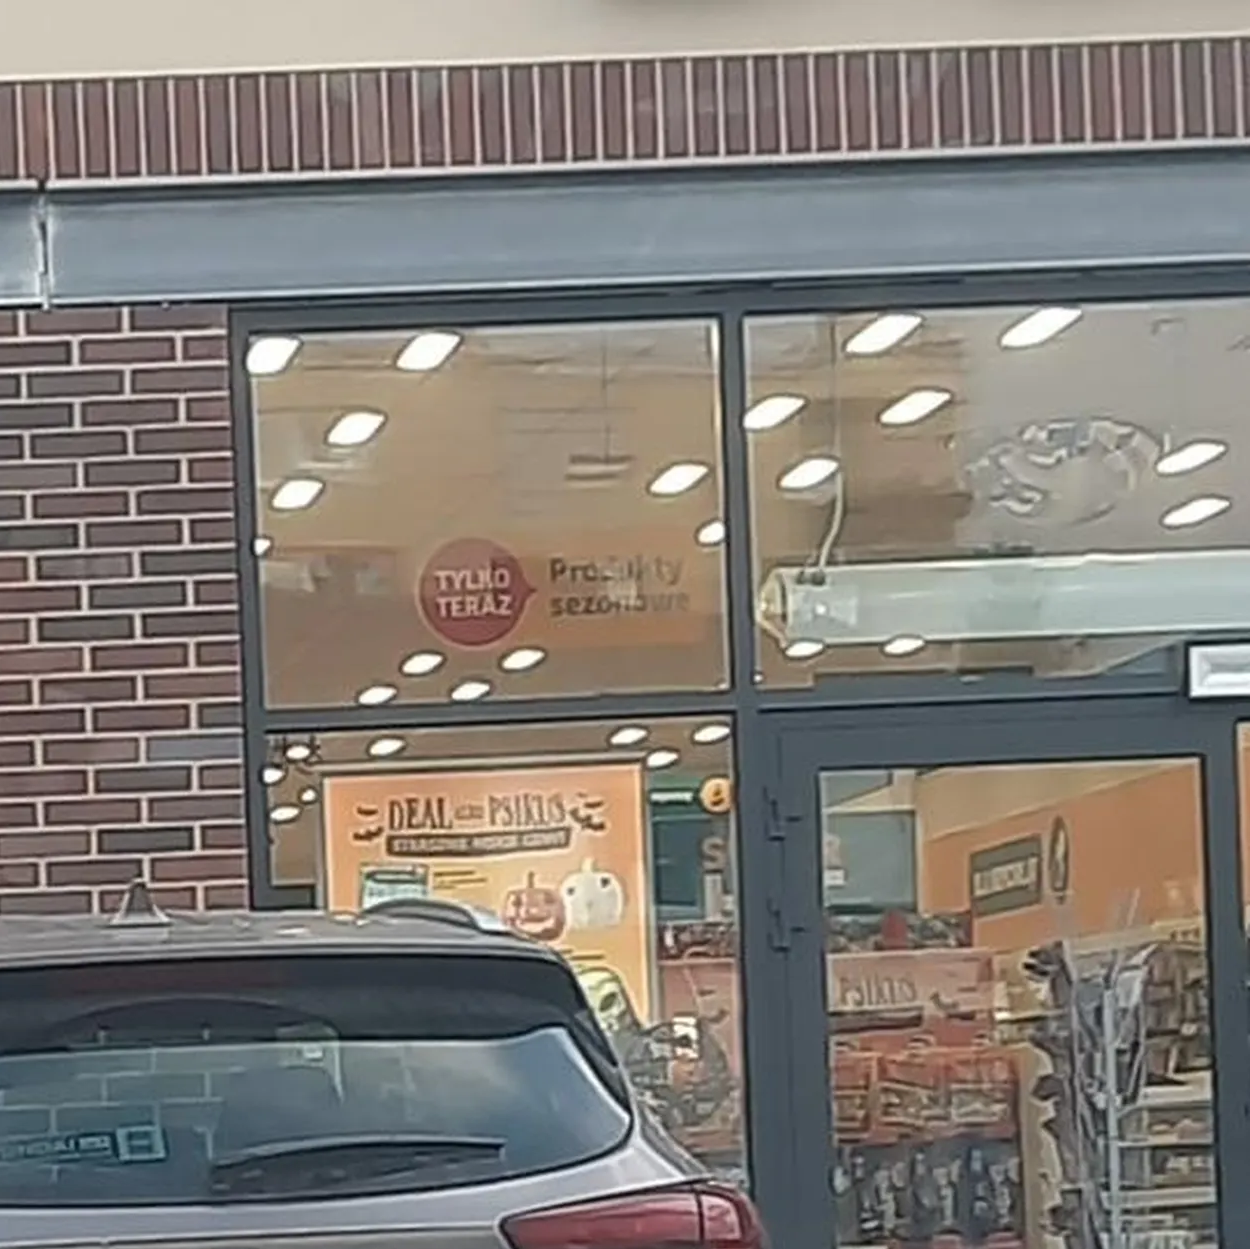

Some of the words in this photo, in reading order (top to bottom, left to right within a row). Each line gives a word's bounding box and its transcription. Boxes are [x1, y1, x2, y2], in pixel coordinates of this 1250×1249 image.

[434, 566, 510, 590] TYLKO
[437, 595, 513, 618] TERAZ
[388, 797, 452, 830] DEAL
